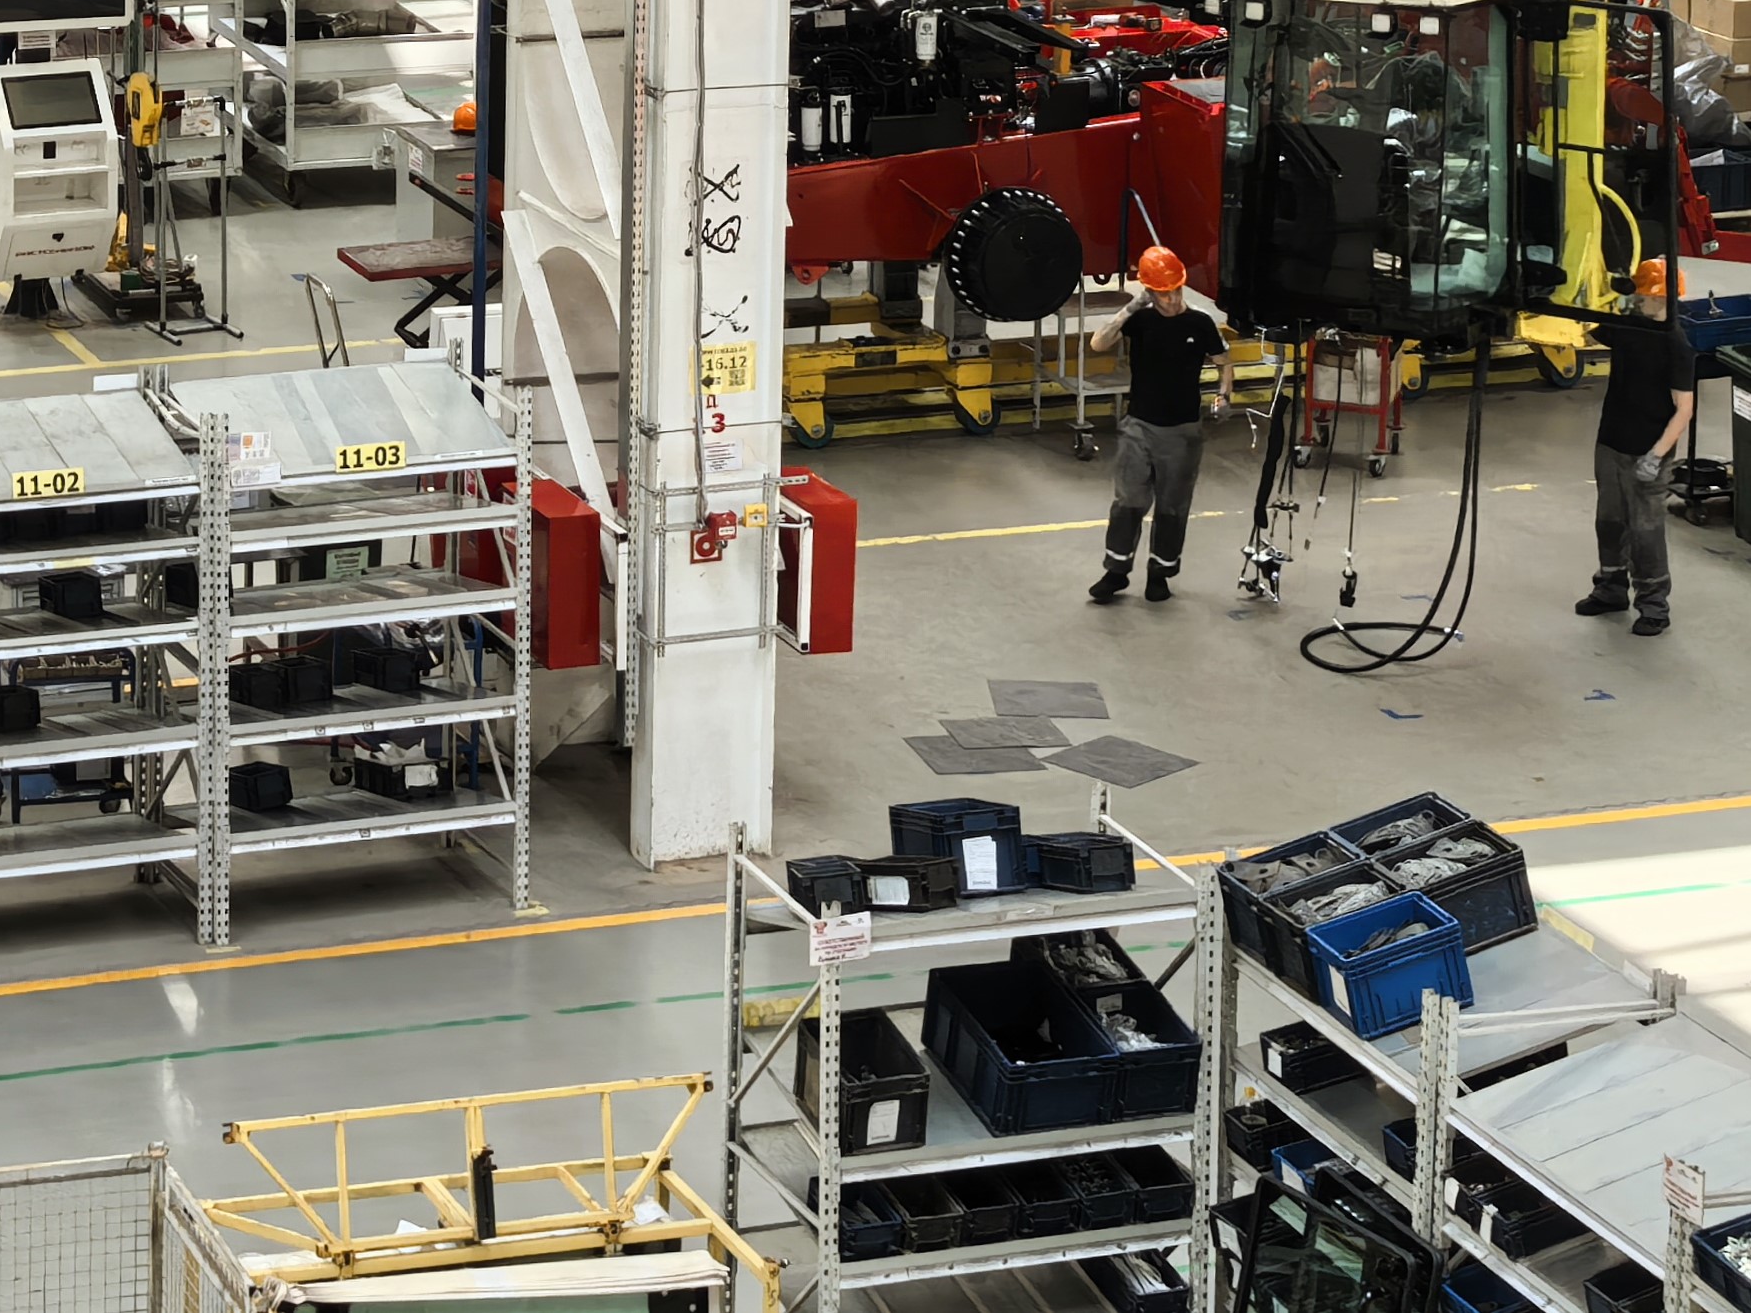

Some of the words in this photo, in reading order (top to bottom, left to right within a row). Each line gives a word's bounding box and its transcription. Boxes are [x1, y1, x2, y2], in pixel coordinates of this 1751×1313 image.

[711, 412, 726, 433] 3
[339, 445, 401, 469] 11-03
[16, 471, 80, 498] 11-02
